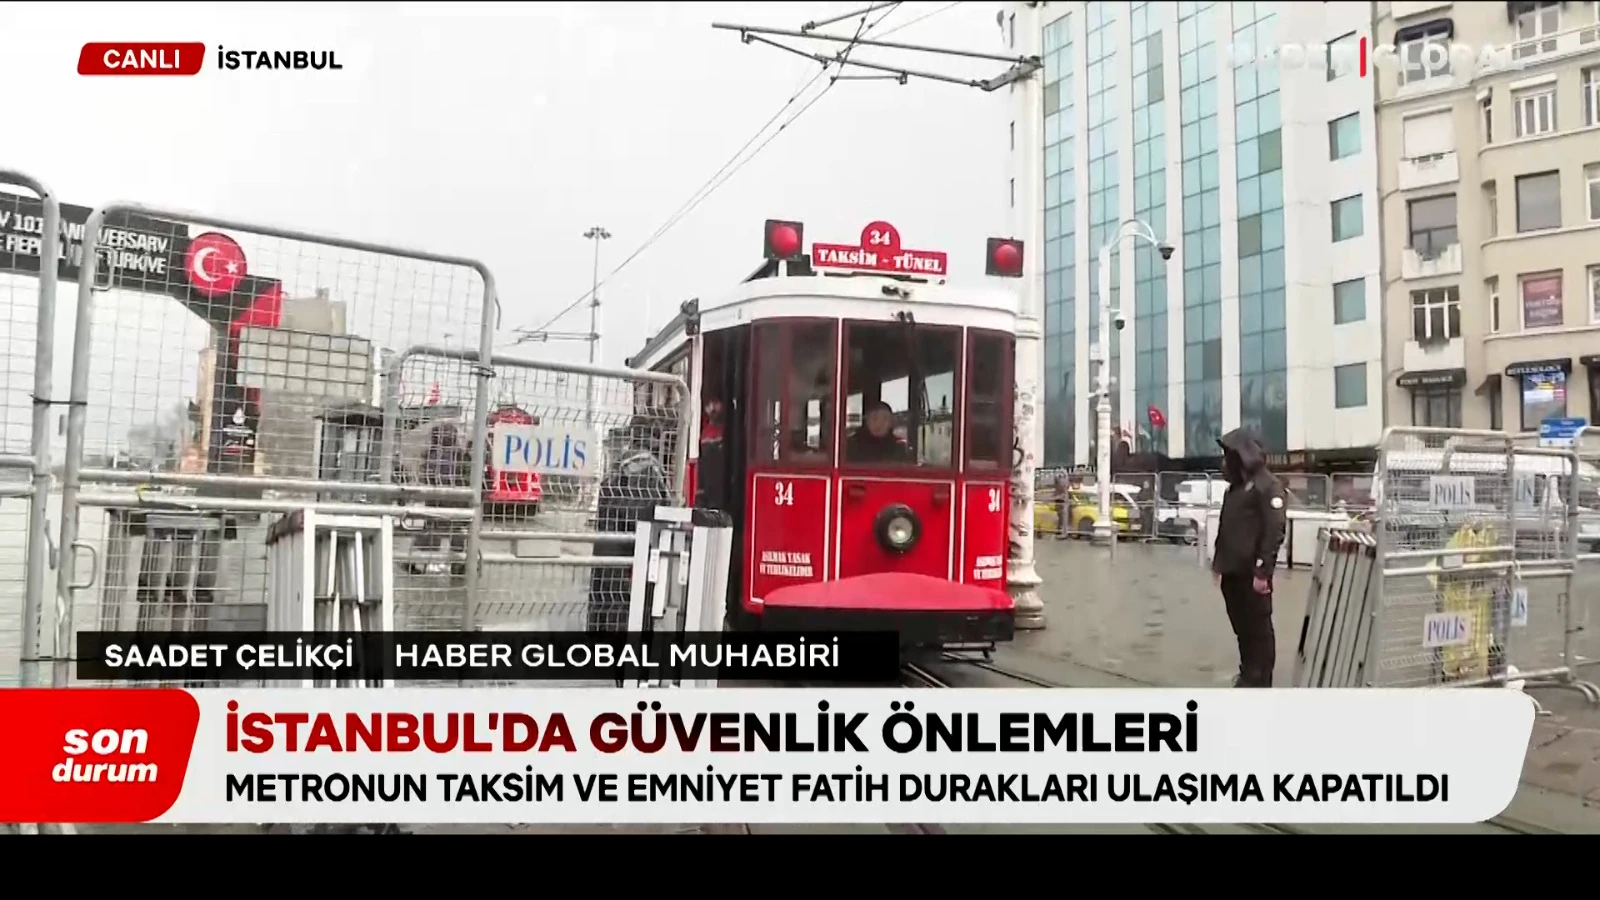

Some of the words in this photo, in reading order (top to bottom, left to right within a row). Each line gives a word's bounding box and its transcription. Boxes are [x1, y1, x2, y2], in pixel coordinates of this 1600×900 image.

[870, 230, 891, 246] 34
[817, 248, 878, 268] TAKSİM
[893, 252, 943, 273] TÜNEL
[504, 434, 587, 469] POLİS
[774, 482, 794, 505] 34
